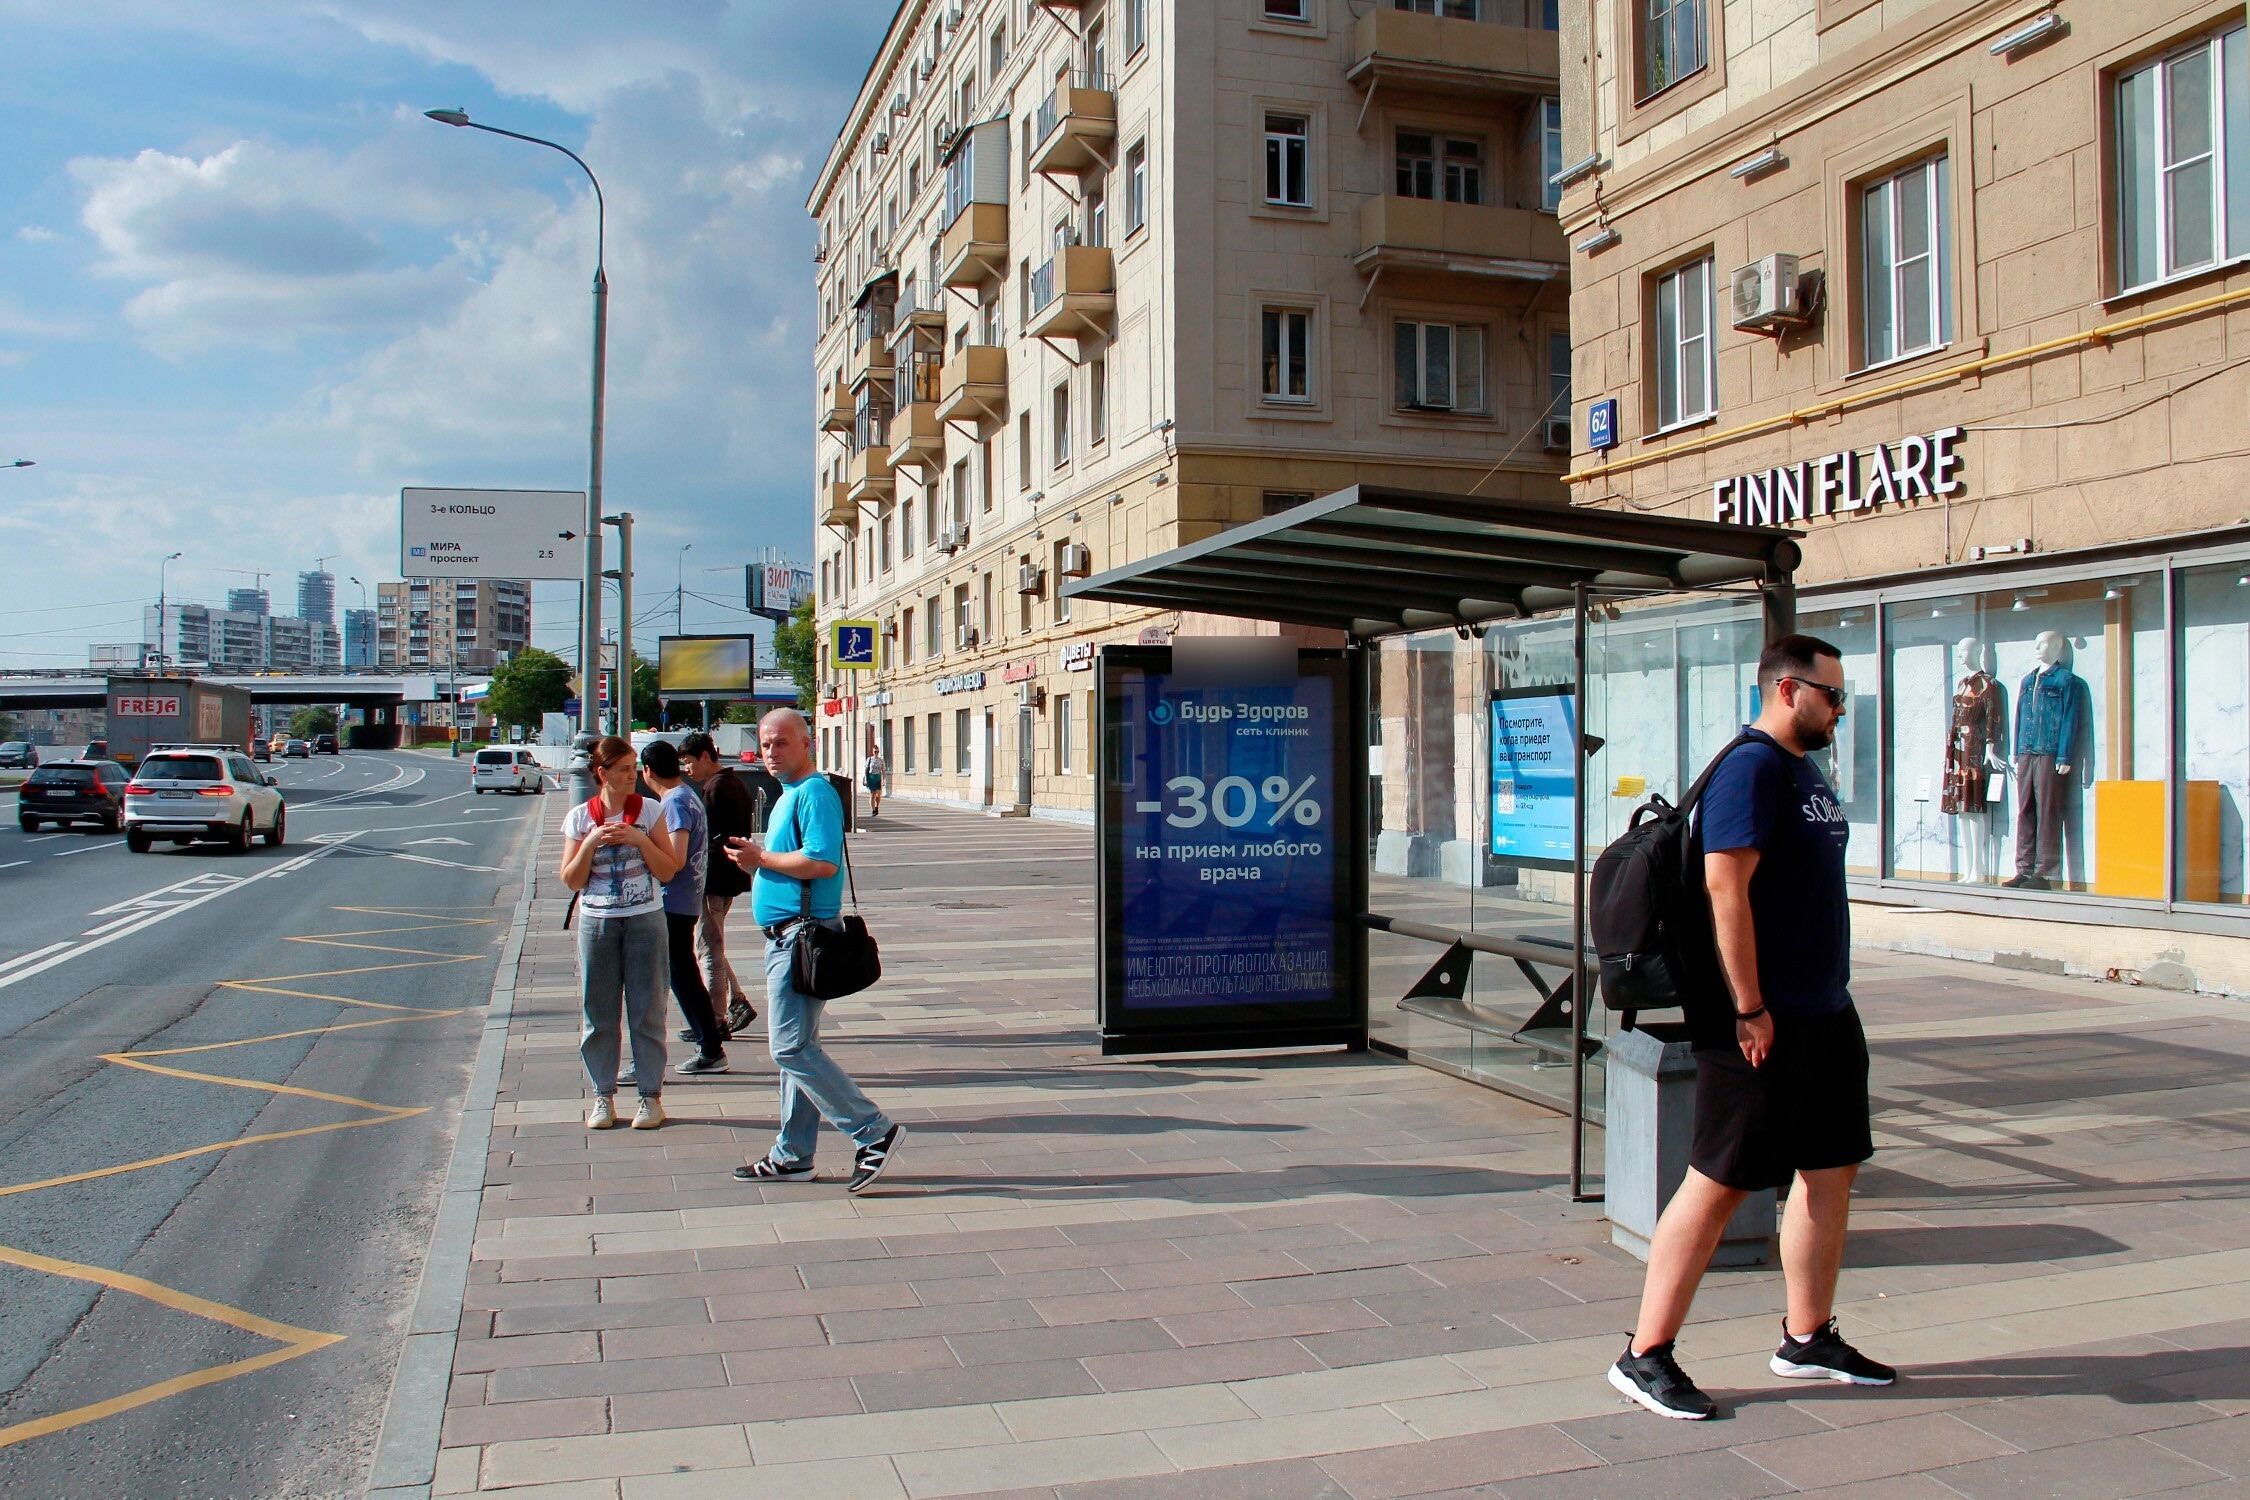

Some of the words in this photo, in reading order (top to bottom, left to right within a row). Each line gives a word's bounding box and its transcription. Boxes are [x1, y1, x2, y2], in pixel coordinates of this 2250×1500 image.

[1592, 409, 1607, 434] 62
[1713, 461, 1809, 527] FINN
[1818, 427, 1963, 516] FLARE
[430, 504, 446, 514] 3-е
[449, 505, 496, 516] КОЛЬЦО
[430, 542, 462, 551] МИРА
[538, 550, 554, 559] 2.5
[430, 554, 480, 564] проспект
[1066, 641, 1092, 663] ЦВЕТЫ
[120, 699, 177, 714] FREJA
[1181, 701, 1233, 723] Будь
[1236, 703, 1309, 723] Здоров
[1236, 728, 1263, 736] сеть
[1265, 728, 1309, 736] клиник
[1499, 717, 1545, 731] Посмотрите,
[1499, 735, 1518, 747] когда
[1520, 734, 1551, 747] приедет
[1499, 752, 1513, 762] ваш
[1514, 751, 1552, 763] транспорт
[1136, 774, 1322, 829] -30%
[1136, 846, 1161, 859] на
[1168, 844, 1236, 863] прием
[1241, 839, 1322, 857] любого
[1200, 866, 1261, 885] врача
[1127, 955, 1191, 977] ИМЕЮТСЯ
[1127, 977, 1190, 998] НЕОБХОДИМА
[1192, 974, 1264, 995] КОНСУЛЬТАЦИЯ
